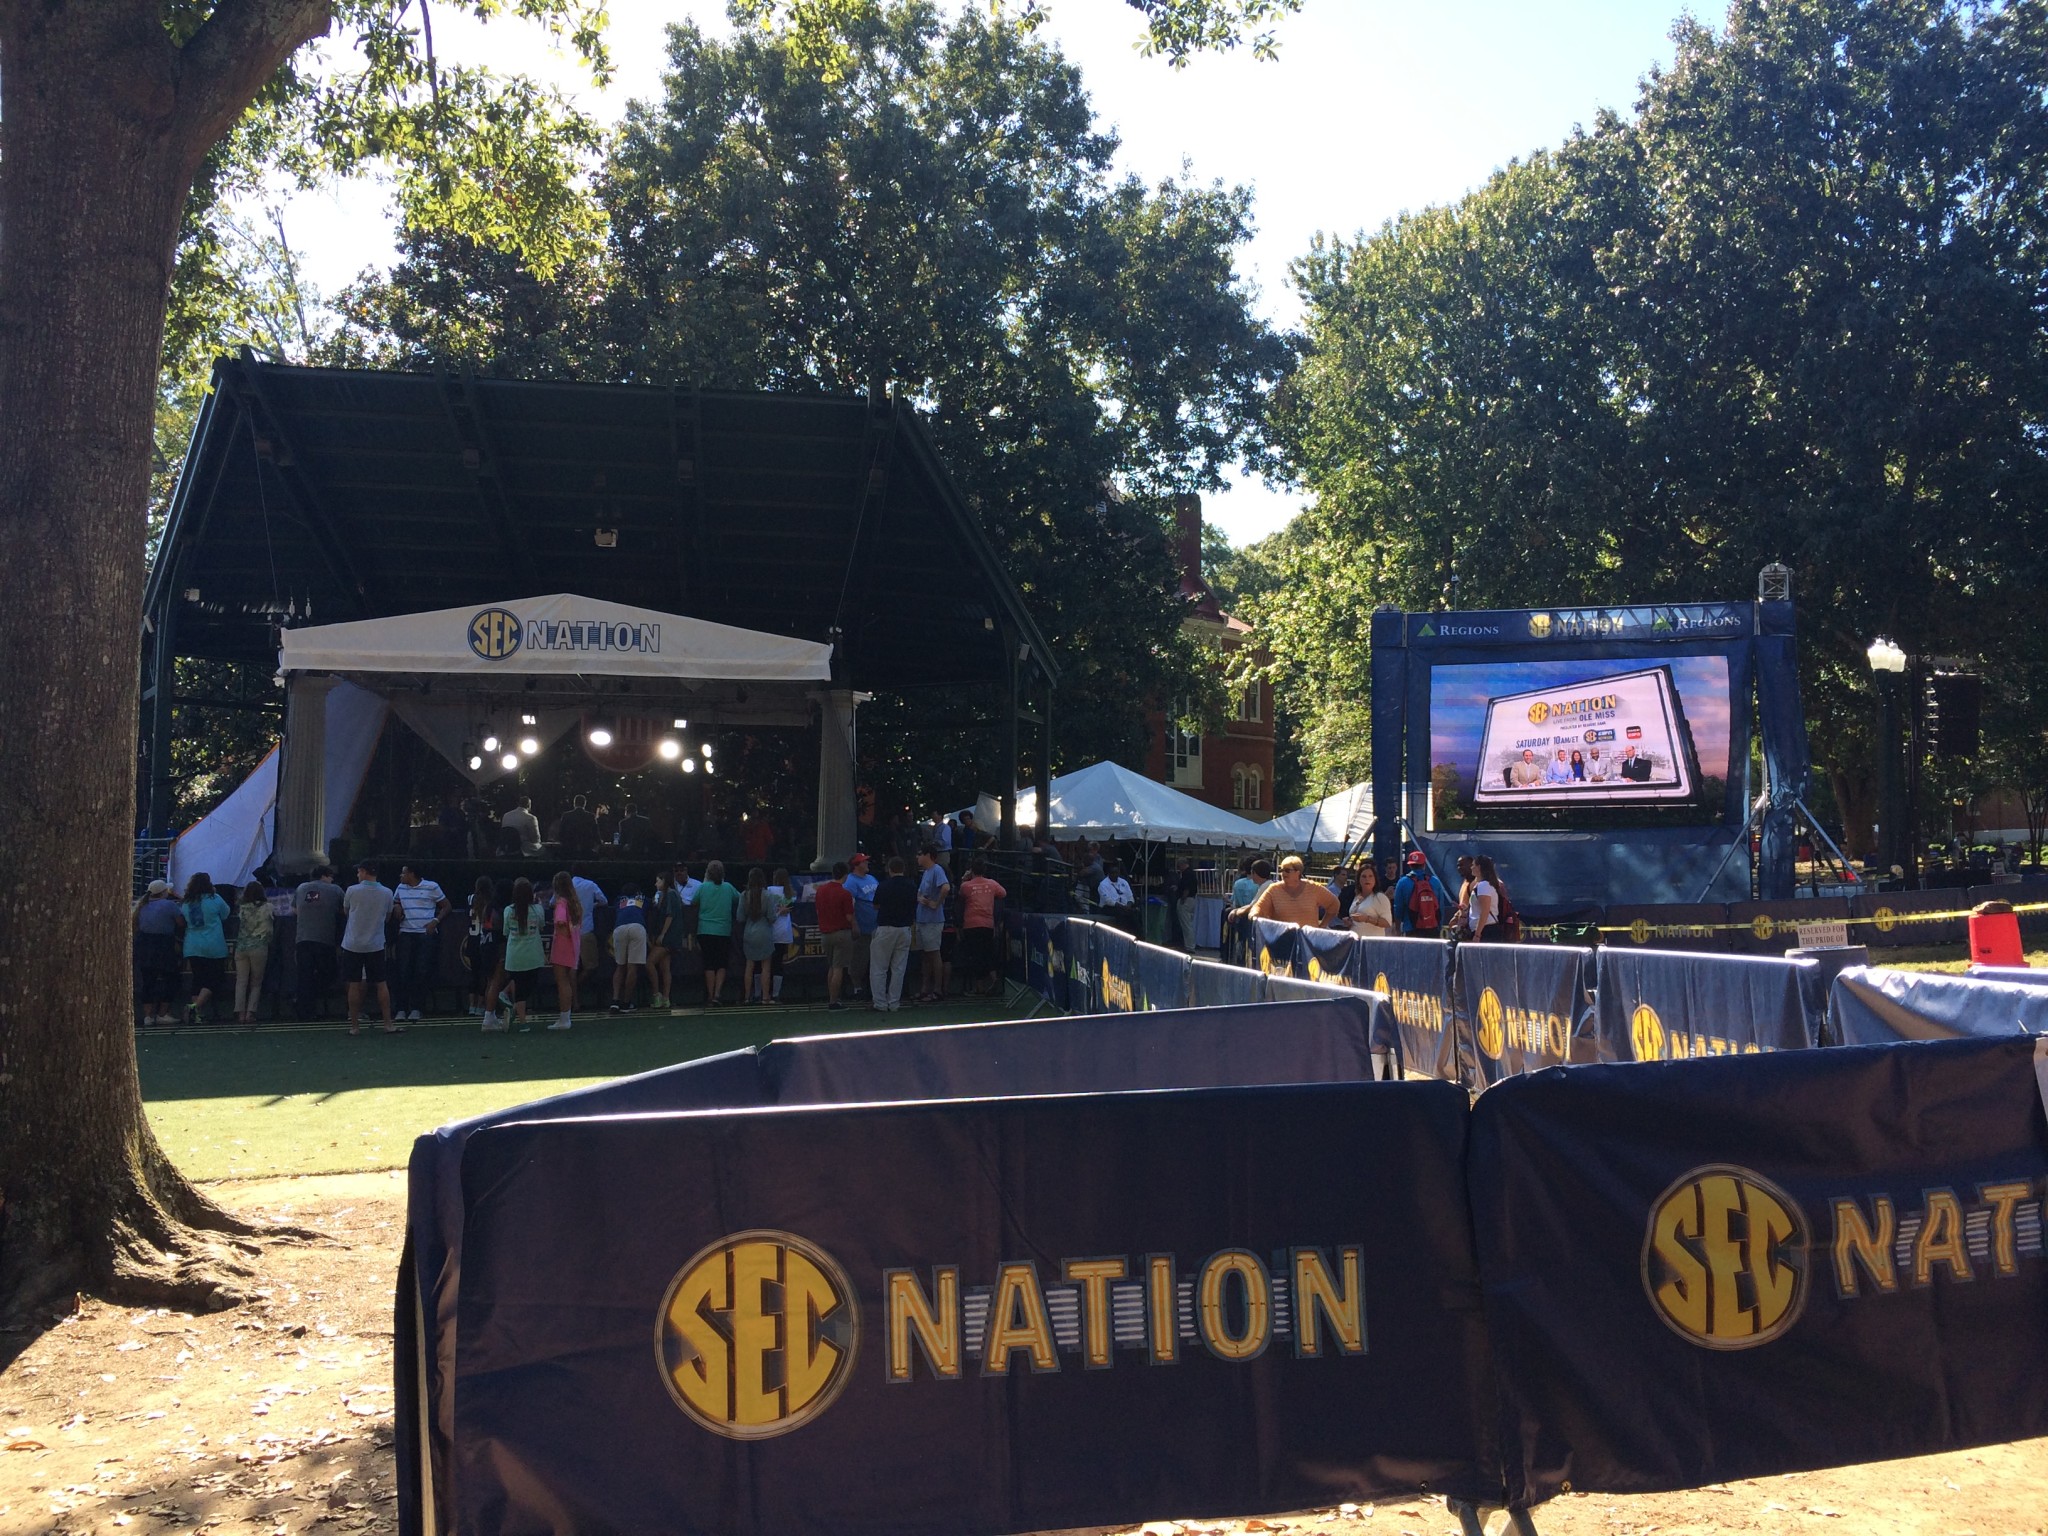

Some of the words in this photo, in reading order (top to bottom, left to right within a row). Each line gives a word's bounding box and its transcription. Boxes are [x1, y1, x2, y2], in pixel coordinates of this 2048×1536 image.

[470, 609, 521, 658] SEC
[526, 620, 660, 653] NATION
[1440, 625, 1499, 636] REGIONS
[1528, 702, 1549, 724] SEC
[1552, 694, 1616, 717] NATION
[1579, 714, 1592, 722] OLE
[1595, 710, 1615, 719] MISS
[1516, 737, 1550, 748] SATURDAY
[1585, 731, 1597, 742] SEC
[1630, 918, 1650, 943] SEC
[1655, 924, 1713, 938] NATION
[1753, 915, 1773, 940] SEC
[1799, 926, 1831, 935] RESERVED
[1832, 924, 1845, 933] FOR
[1873, 907, 1895, 931] SEC
[1801, 937, 1815, 945] THE
[1816, 935, 1835, 944] PRIDE
[1836, 934, 1844, 942] OF
[1391, 986, 1442, 1033] NATION
[1647, 1168, 1803, 1343] SEC
[1829, 1176, 2048, 1300] NAT
[662, 1237, 853, 1430] SEC
[884, 1244, 1368, 1383] NATION
